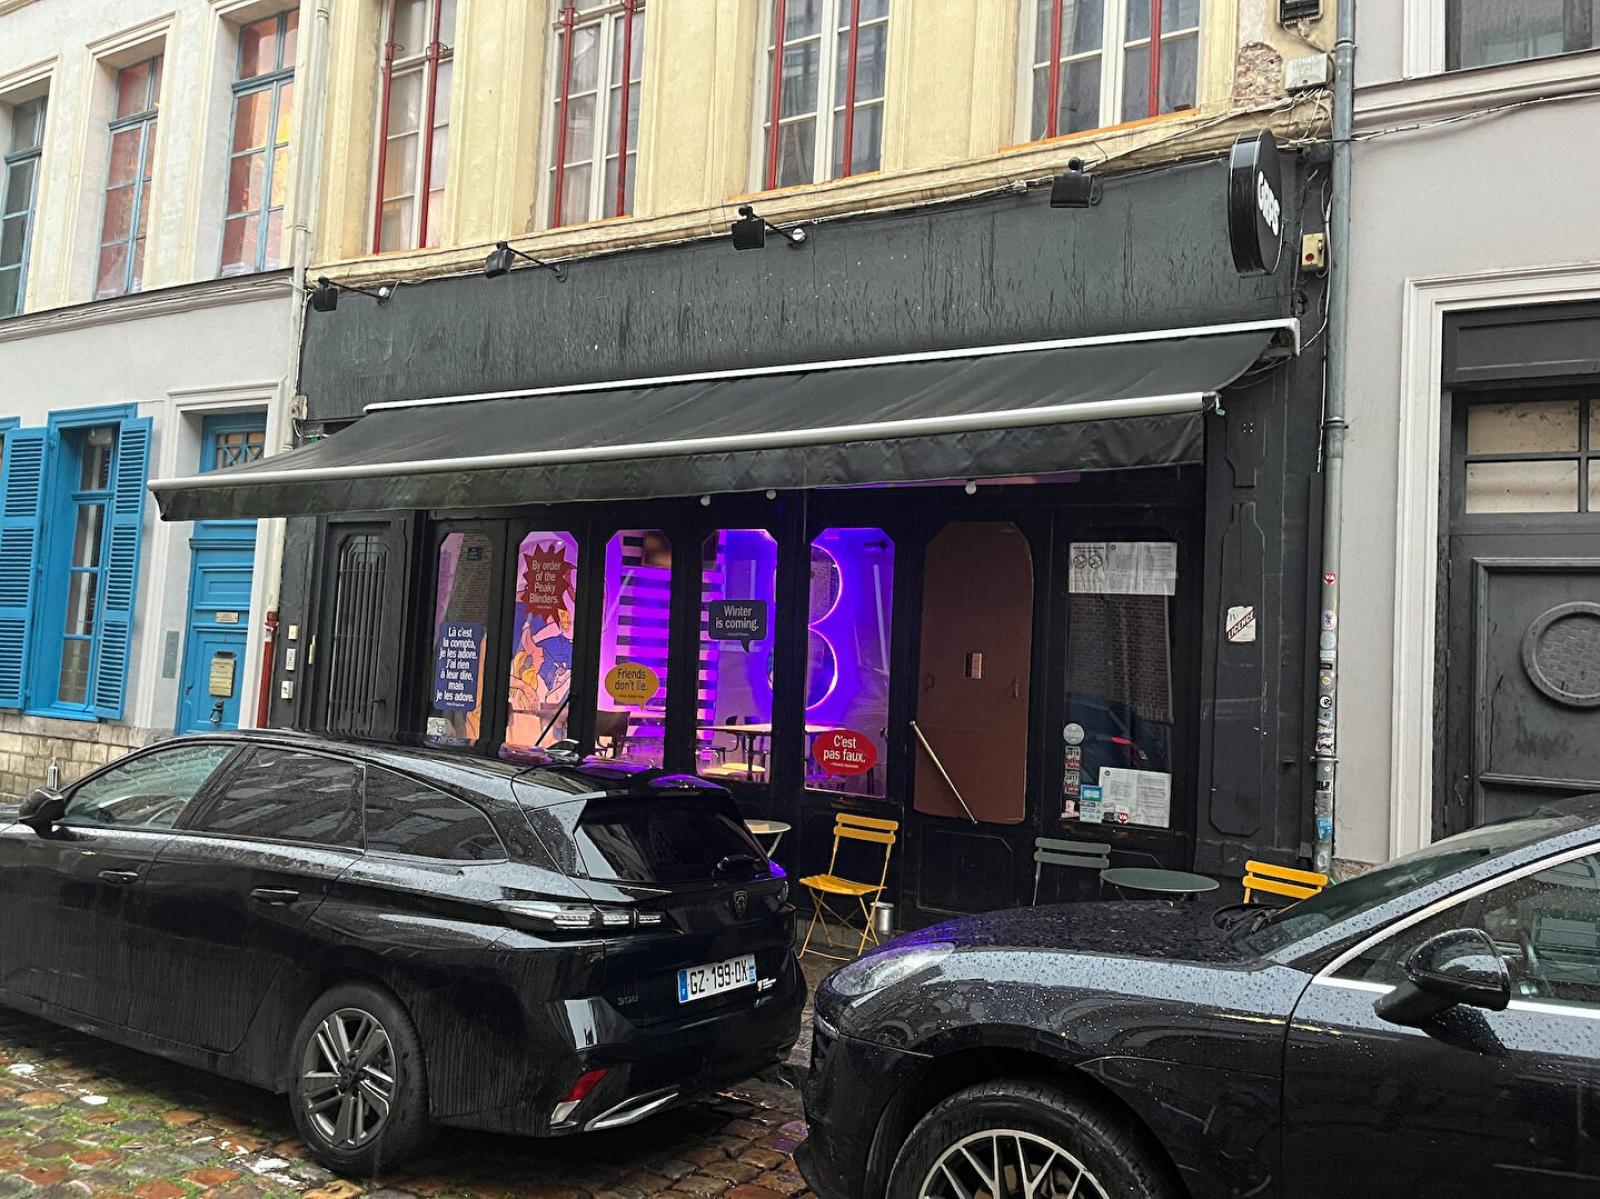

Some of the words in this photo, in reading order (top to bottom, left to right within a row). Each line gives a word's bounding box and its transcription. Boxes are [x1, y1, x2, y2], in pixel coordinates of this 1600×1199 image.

[532, 560, 541, 572] By
[543, 561, 561, 570] order
[535, 571, 543, 581] of
[544, 572, 556, 581] the
[534, 582, 557, 595] Peaky
[529, 593, 559, 603] Blinders.
[723, 604, 752, 617] Winter
[715, 617, 724, 629] is
[725, 618, 759, 631] coming.
[1228, 610, 1254, 640] LICENCE
[448, 627, 457, 637] Là
[457, 628, 472, 638] c'est
[443, 637, 449, 647] la
[450, 639, 476, 649] compta,
[439, 647, 446, 660] je
[447, 649, 456, 658] les
[457, 650, 477, 659] adore.
[446, 659, 456, 669] J'ai
[457, 660, 469, 670] rien
[440, 669, 445, 679] à
[446, 670, 458, 679] leur
[460, 671, 473, 681] dire,
[617, 669, 646, 679] Friends
[448, 681, 464, 690] mais
[615, 680, 635, 691] don't
[636, 680, 648, 691] lie.
[436, 690, 443, 702] je
[444, 690, 453, 701] les
[454, 691, 474, 702] adore.
[833, 734, 857, 749] C'est
[823, 749, 841, 761] pas
[842, 748, 866, 763] faux.
